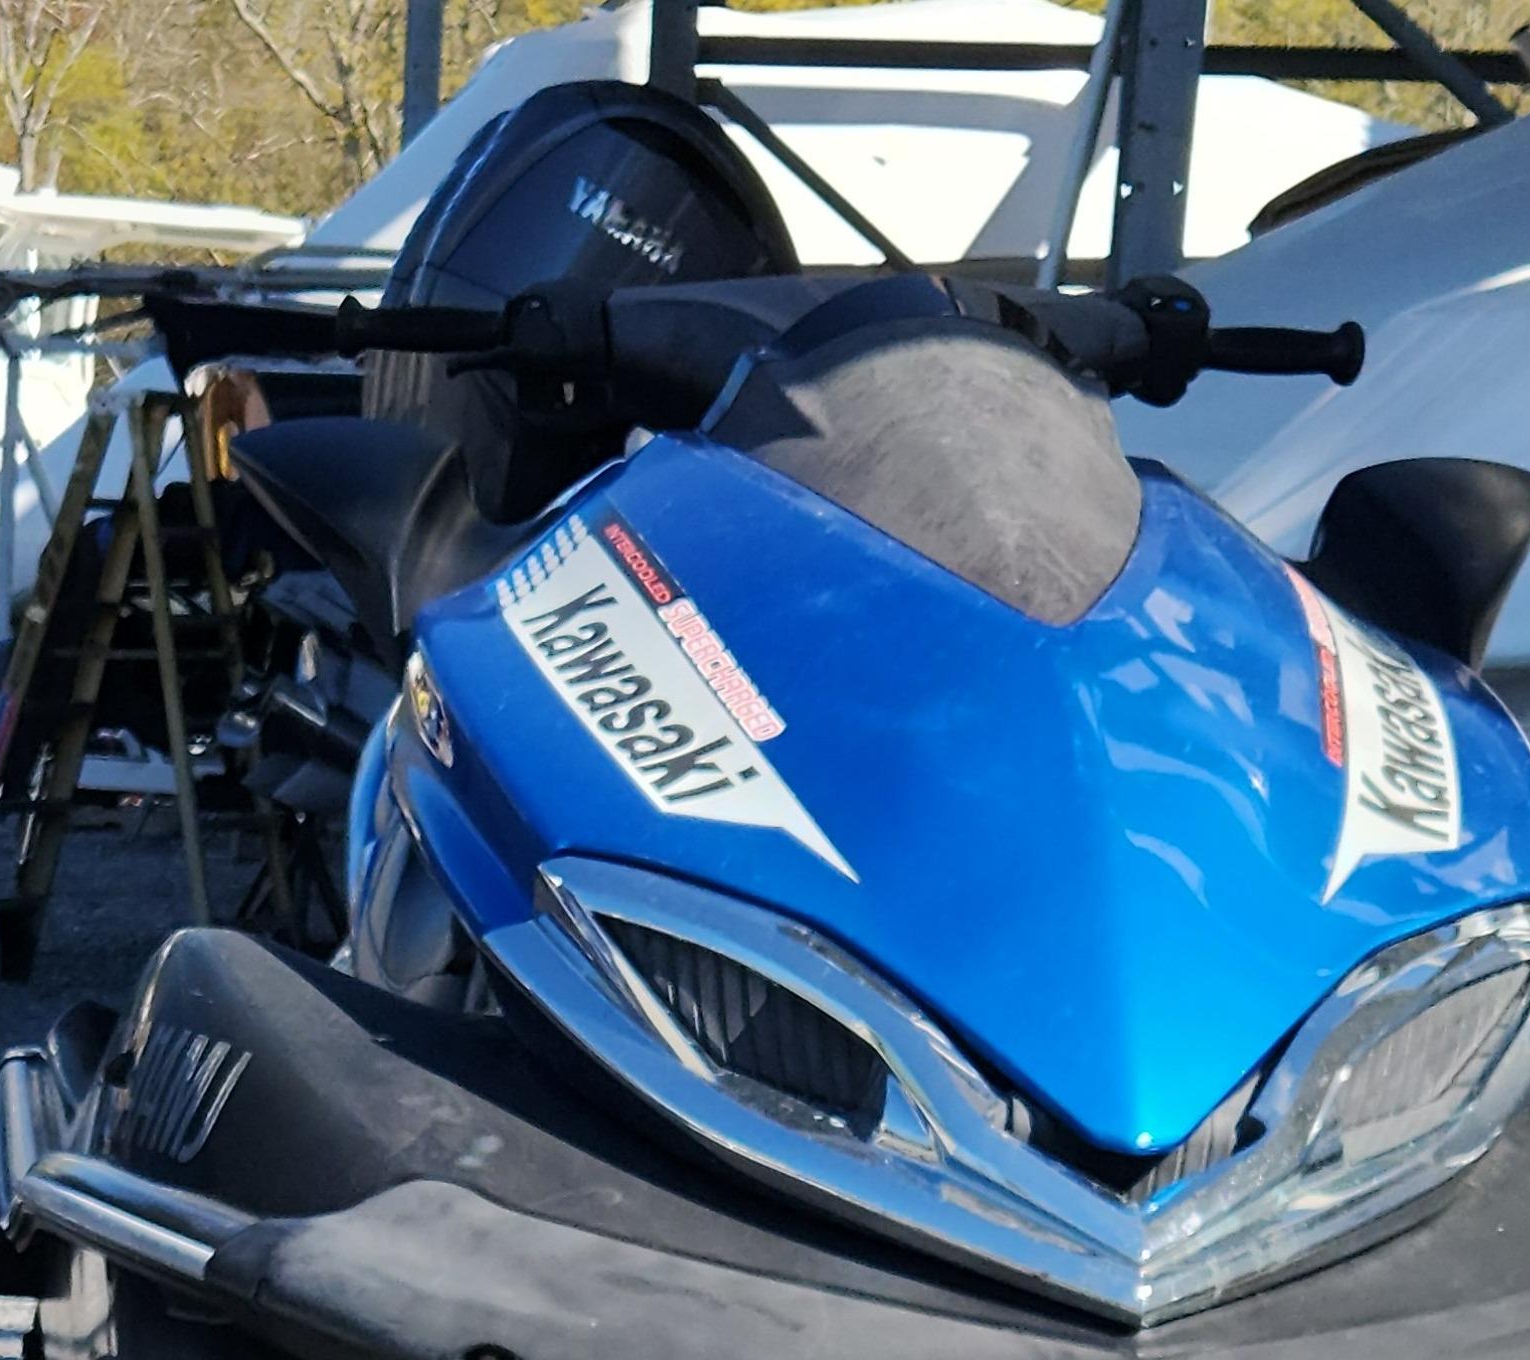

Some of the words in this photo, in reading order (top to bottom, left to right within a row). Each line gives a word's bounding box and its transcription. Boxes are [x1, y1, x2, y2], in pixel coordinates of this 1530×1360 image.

[603, 523, 672, 604] INTERCOOLED
[520, 583, 761, 805] Kawasaki
[661, 600, 779, 741] SUPERCHARGED
